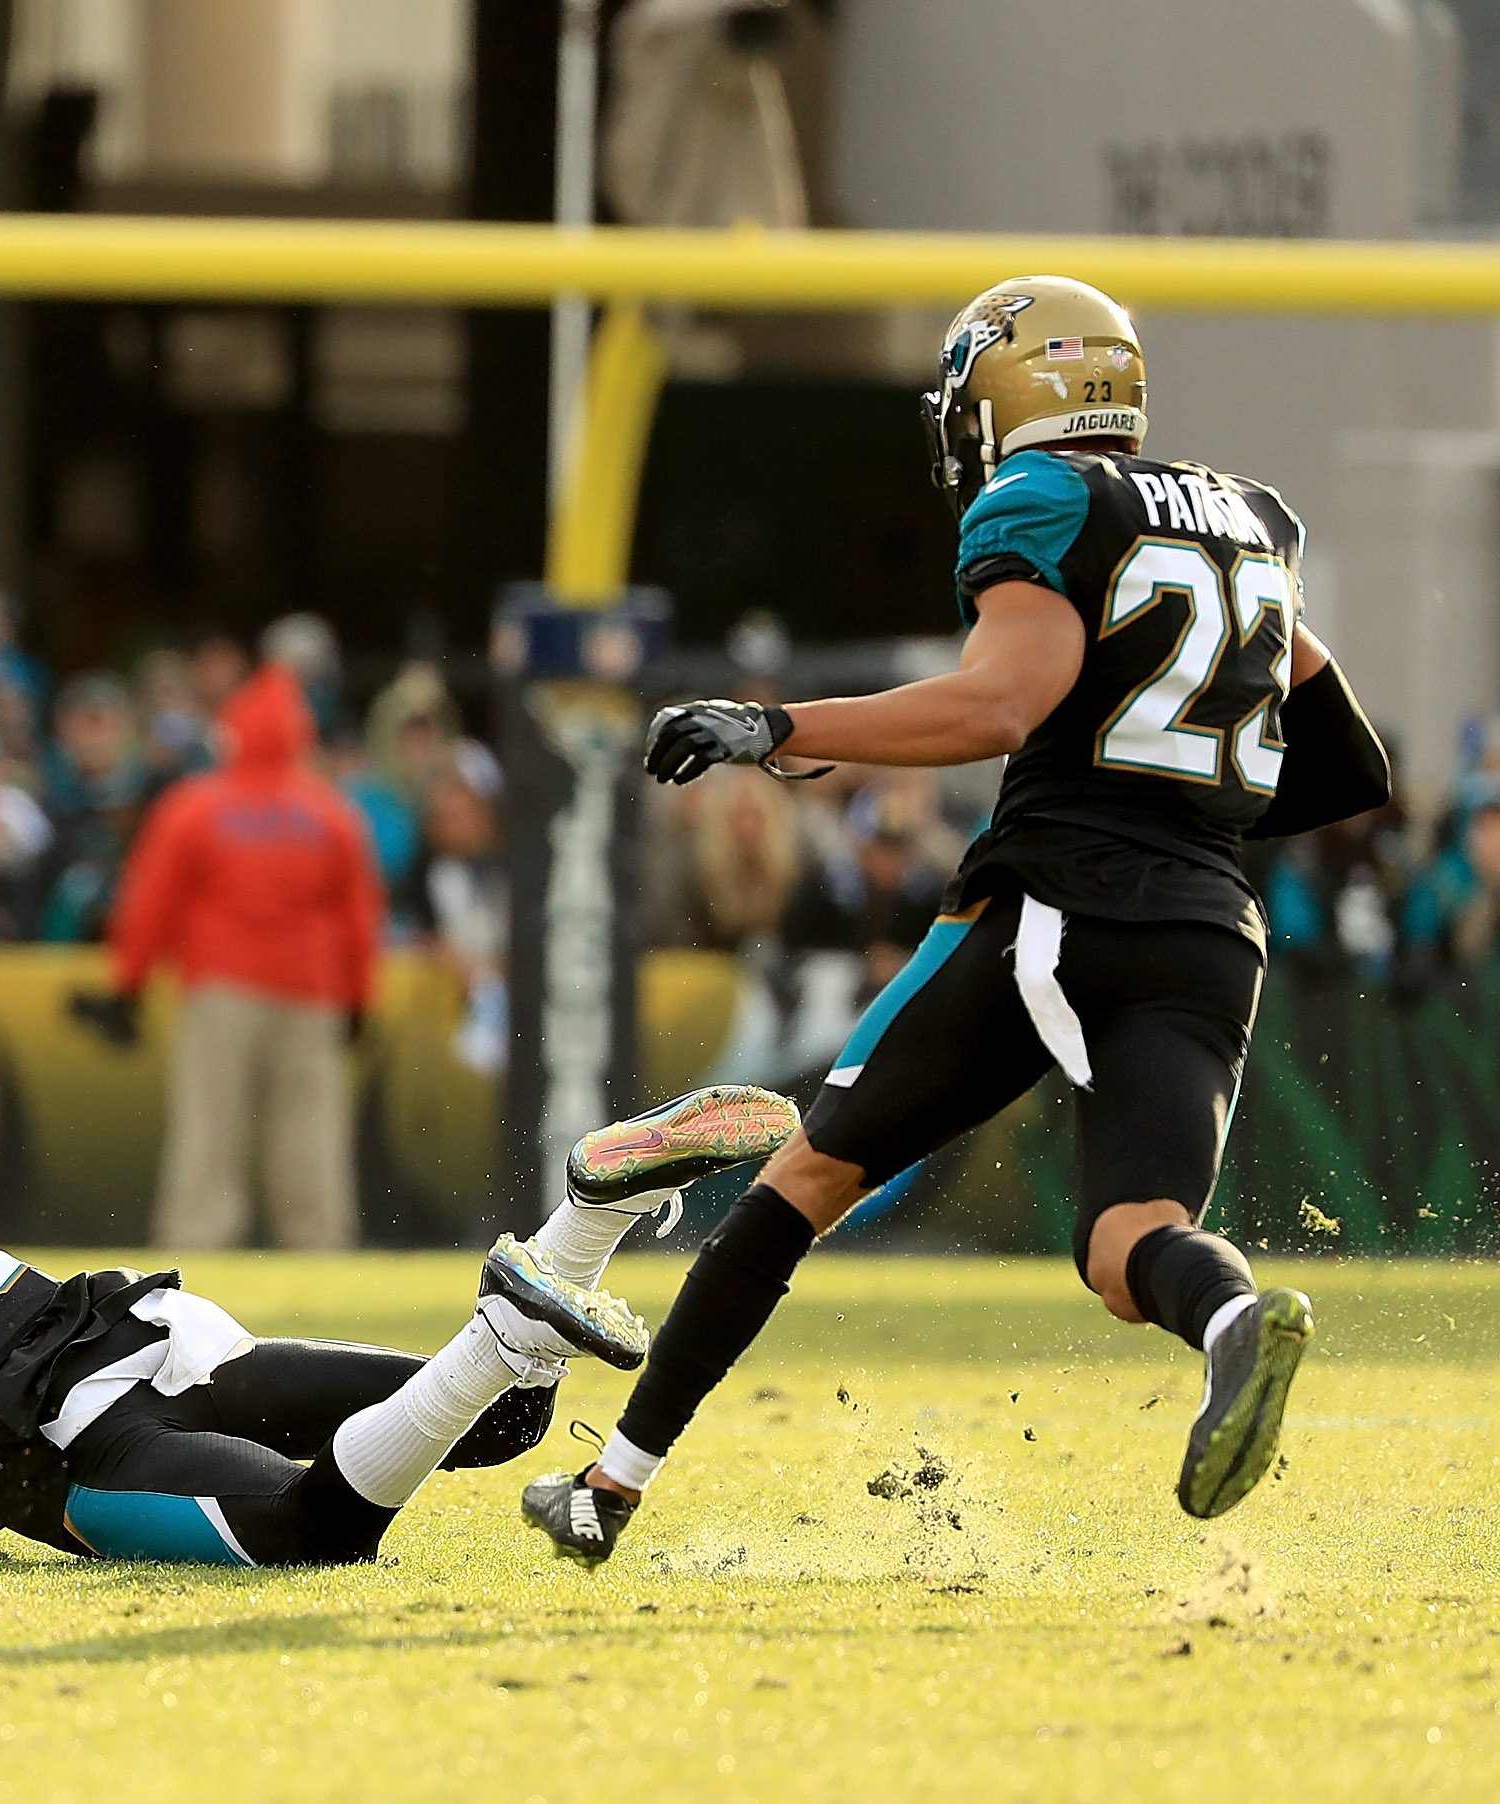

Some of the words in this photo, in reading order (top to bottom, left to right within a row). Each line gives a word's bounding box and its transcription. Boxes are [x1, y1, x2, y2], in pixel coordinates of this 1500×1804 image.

[1084, 381, 1112, 403] 23
[1063, 412, 1137, 434] JAGUARS
[1093, 534, 1293, 798] 23
